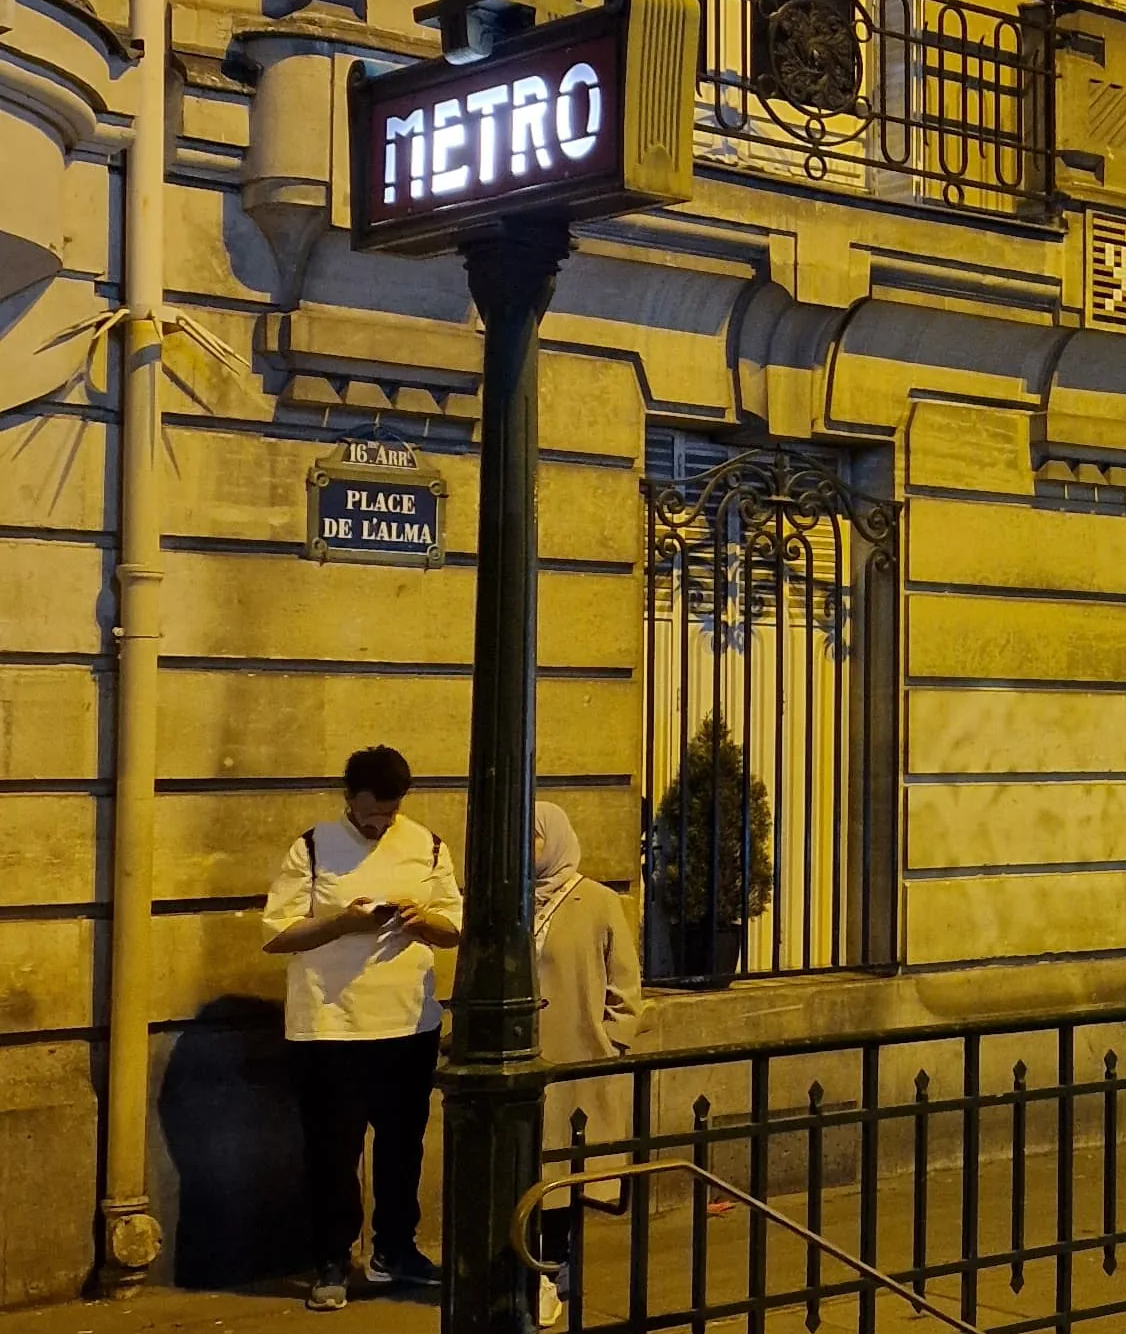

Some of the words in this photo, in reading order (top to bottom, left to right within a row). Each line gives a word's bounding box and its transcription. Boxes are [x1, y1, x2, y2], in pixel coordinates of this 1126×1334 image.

[383, 62, 601, 205] METRO
[345, 489, 416, 515] PLACE
[323, 518, 353, 538] DE
[362, 517, 433, 544] L'ALMA
